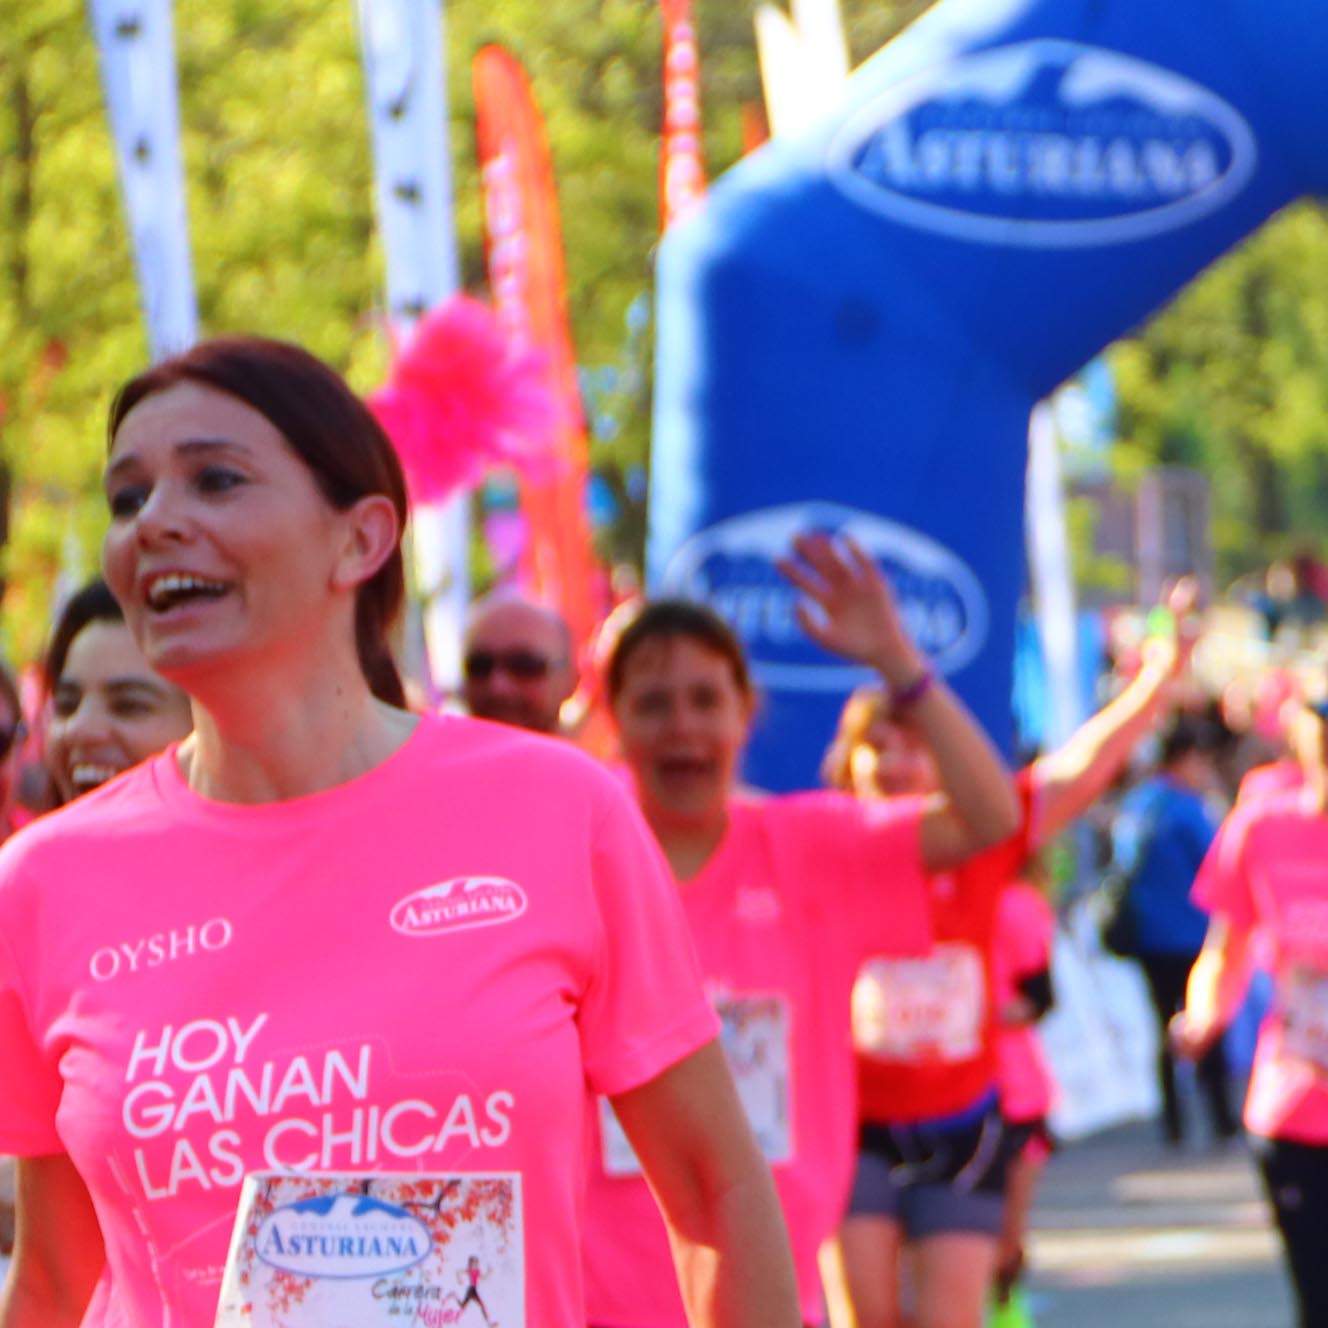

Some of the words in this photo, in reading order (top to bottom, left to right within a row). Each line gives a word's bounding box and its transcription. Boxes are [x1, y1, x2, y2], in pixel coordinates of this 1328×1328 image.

[89, 918, 233, 981] OYSHO
[125, 1012, 268, 1081] HOY
[123, 1044, 371, 1139] GANAN
[133, 1129, 245, 1200] LAS
[264, 1091, 514, 1174] CHICAS
[263, 1223, 418, 1257] ASTURIANA
